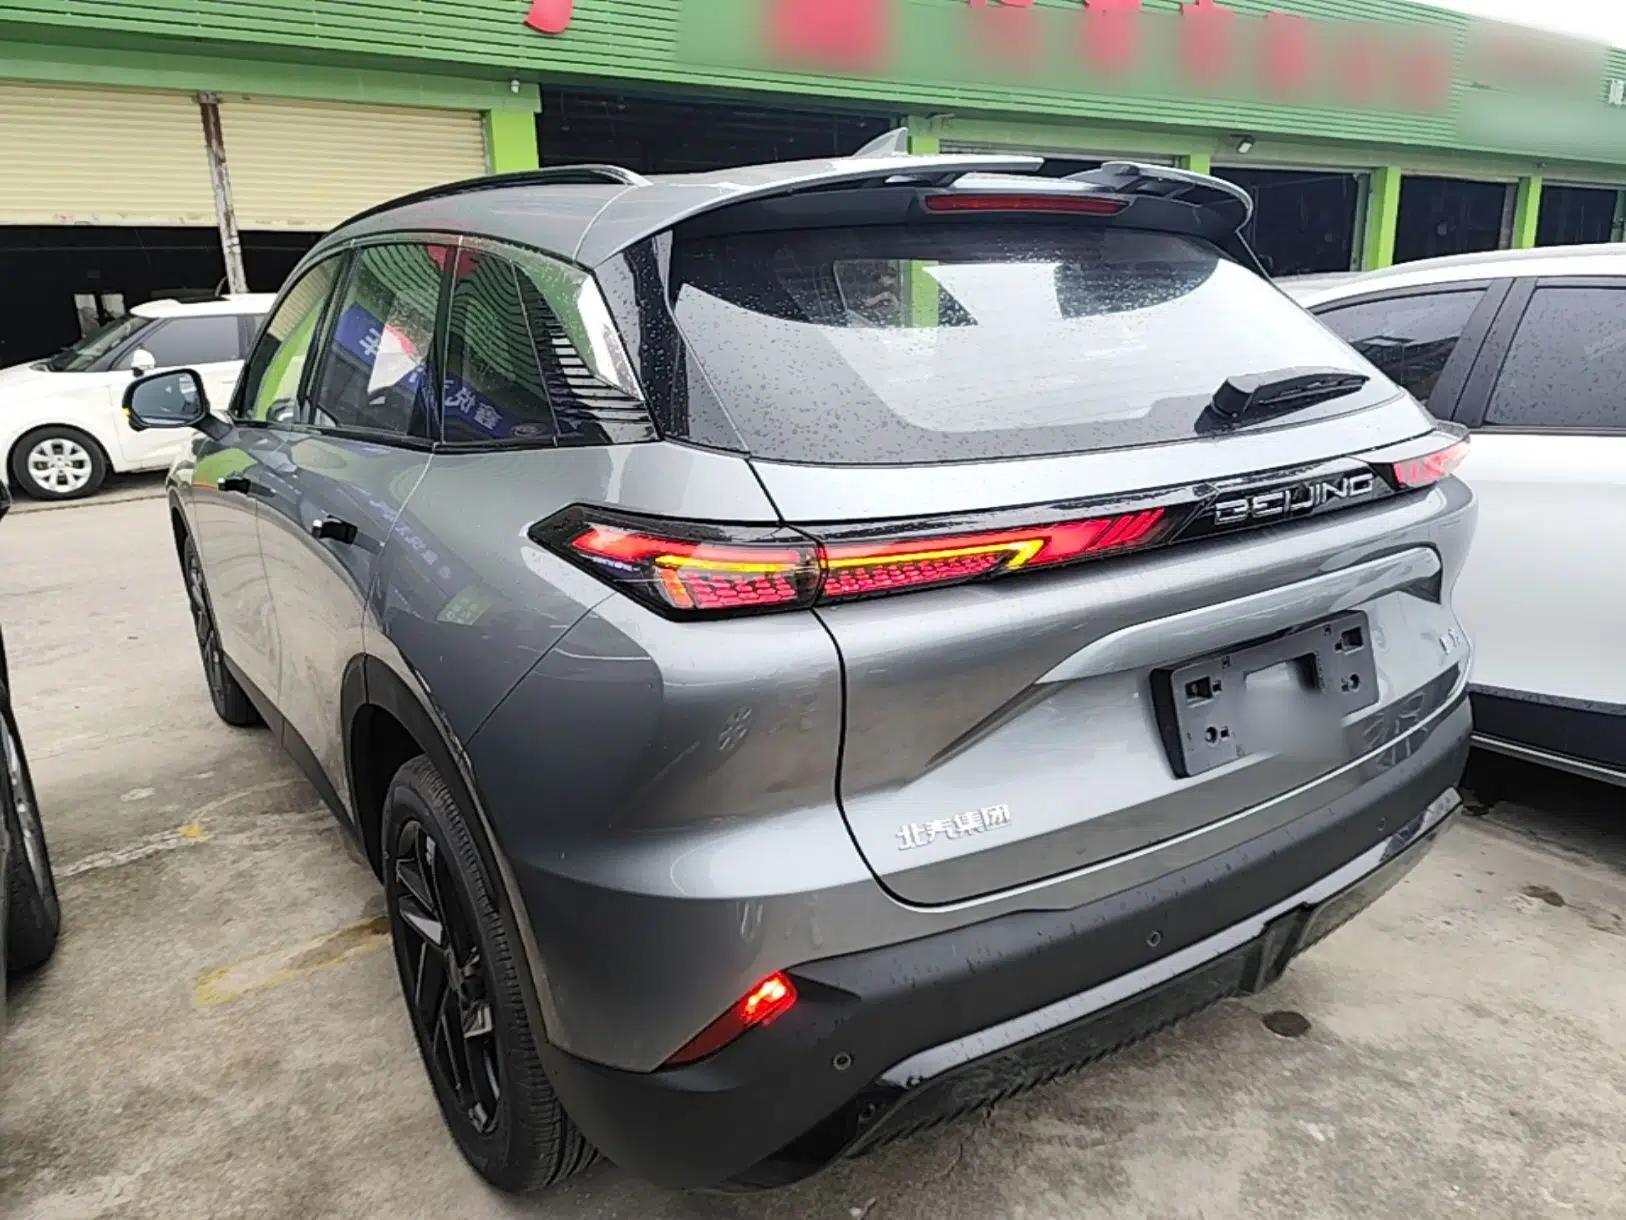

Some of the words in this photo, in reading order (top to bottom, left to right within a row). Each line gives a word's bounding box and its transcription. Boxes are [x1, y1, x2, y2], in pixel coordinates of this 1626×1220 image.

[1214, 473, 1374, 525] BEIJING
[896, 804, 1011, 851] 北汽集团
